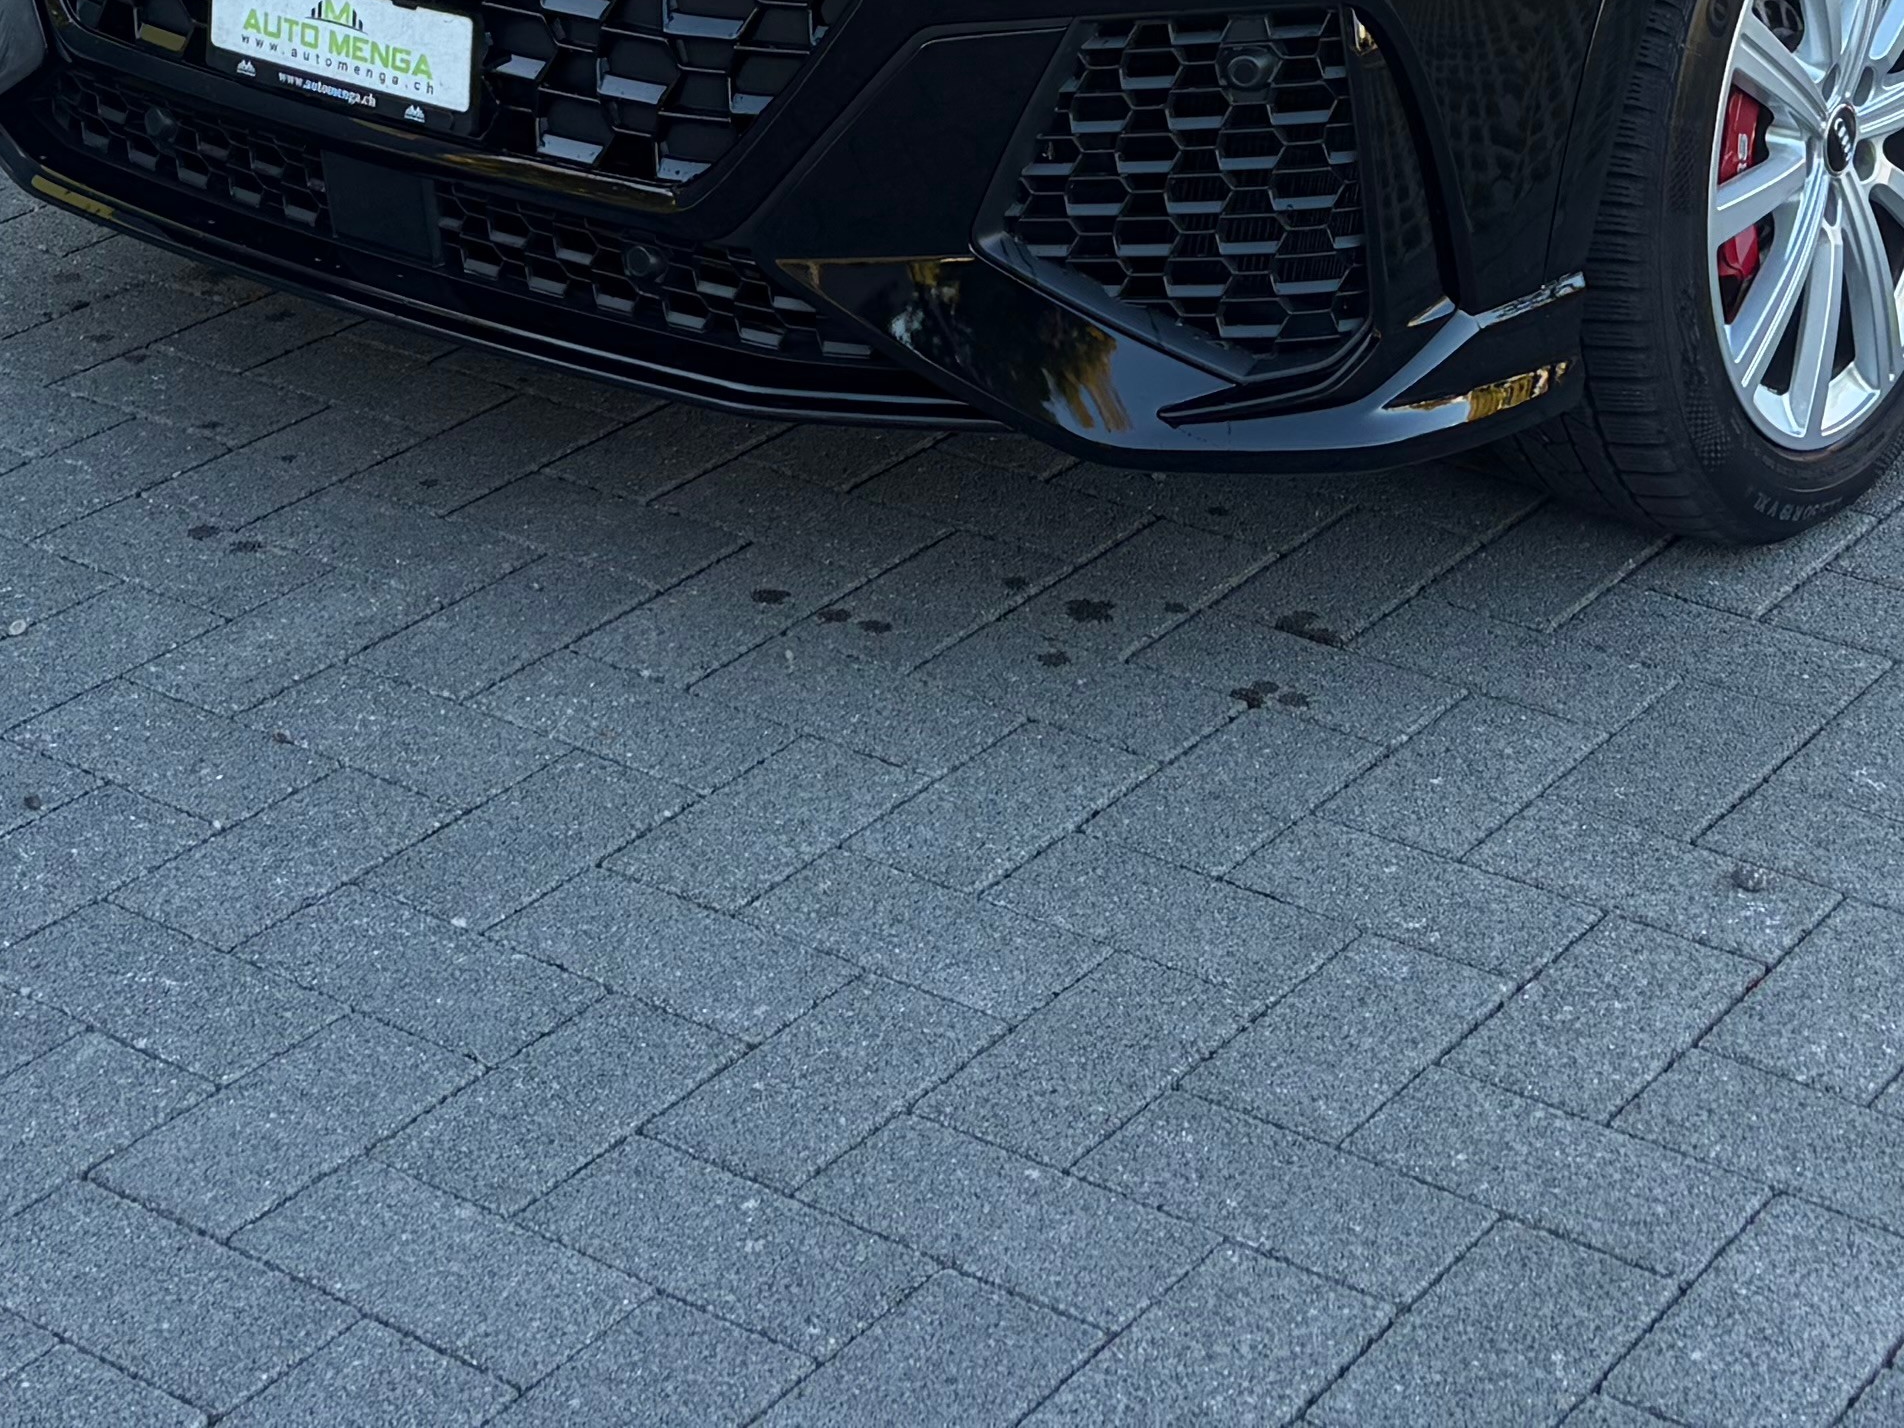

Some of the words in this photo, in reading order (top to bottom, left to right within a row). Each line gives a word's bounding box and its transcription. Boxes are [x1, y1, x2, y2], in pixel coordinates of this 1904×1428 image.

[241, 33, 435, 95] www.automenga.ch
[243, 8, 320, 50] AUTO
[328, 29, 434, 81] MENGA
[278, 72, 378, 108] www.automenga.ch
